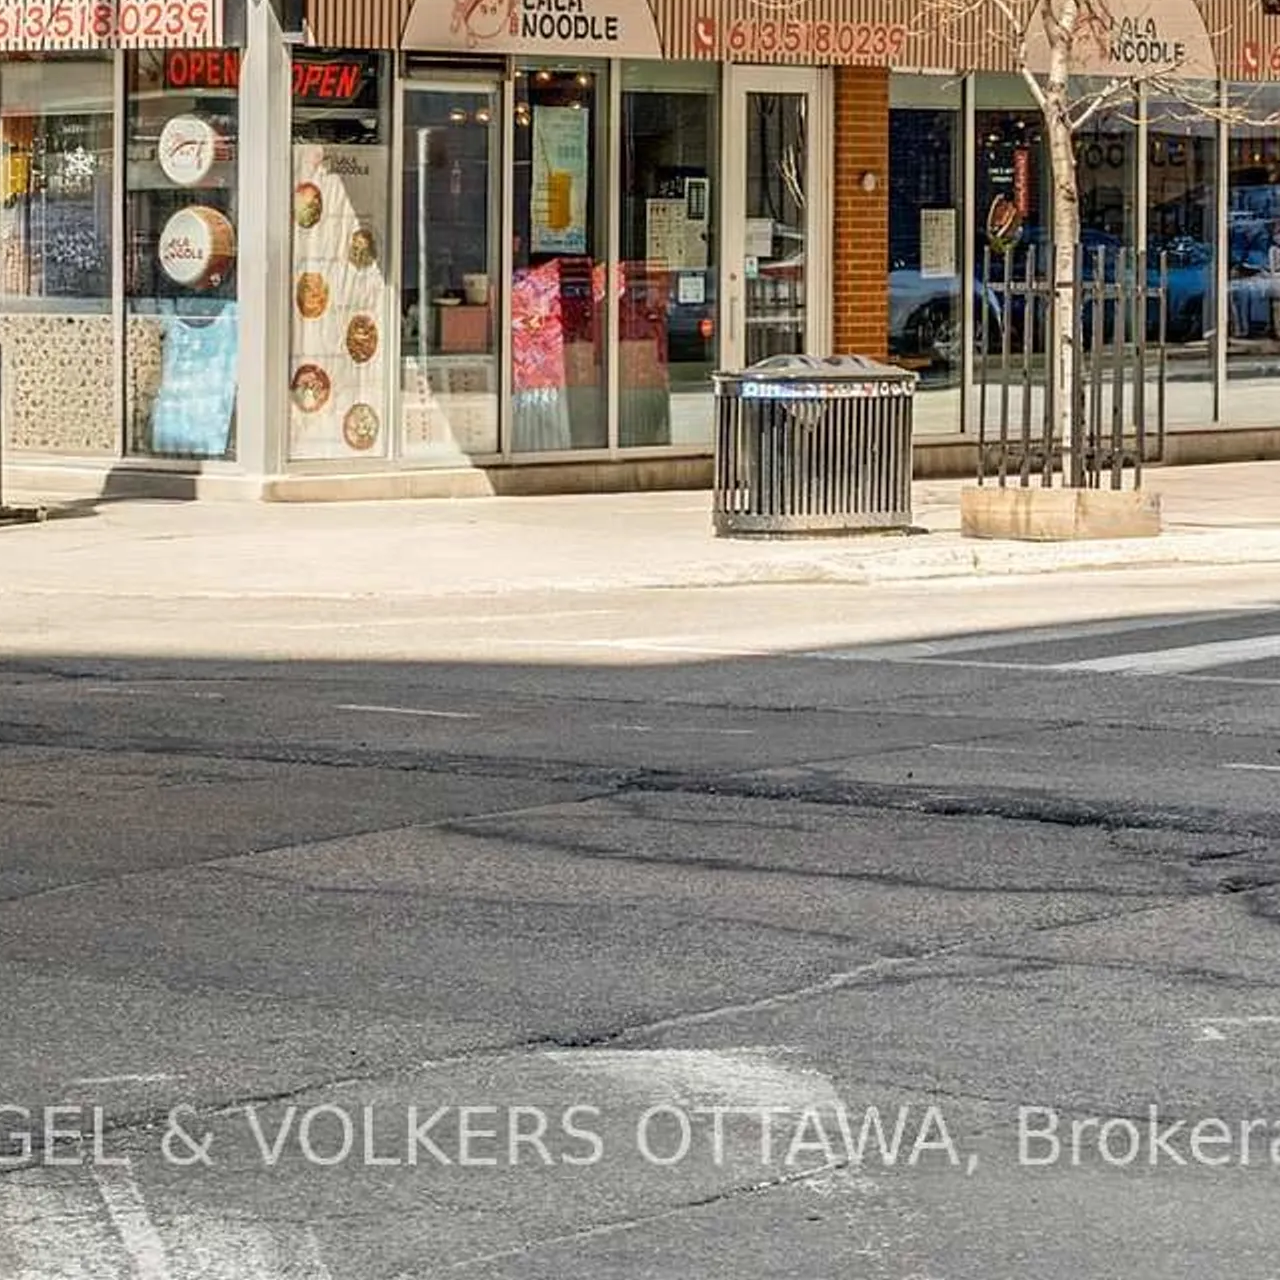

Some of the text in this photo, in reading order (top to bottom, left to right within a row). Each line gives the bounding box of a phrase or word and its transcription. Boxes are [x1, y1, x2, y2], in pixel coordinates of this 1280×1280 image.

[521, 13, 619, 40] NOODLE
[728, 23, 905, 54] 613.518.0239
[170, 52, 238, 86] OPEN
